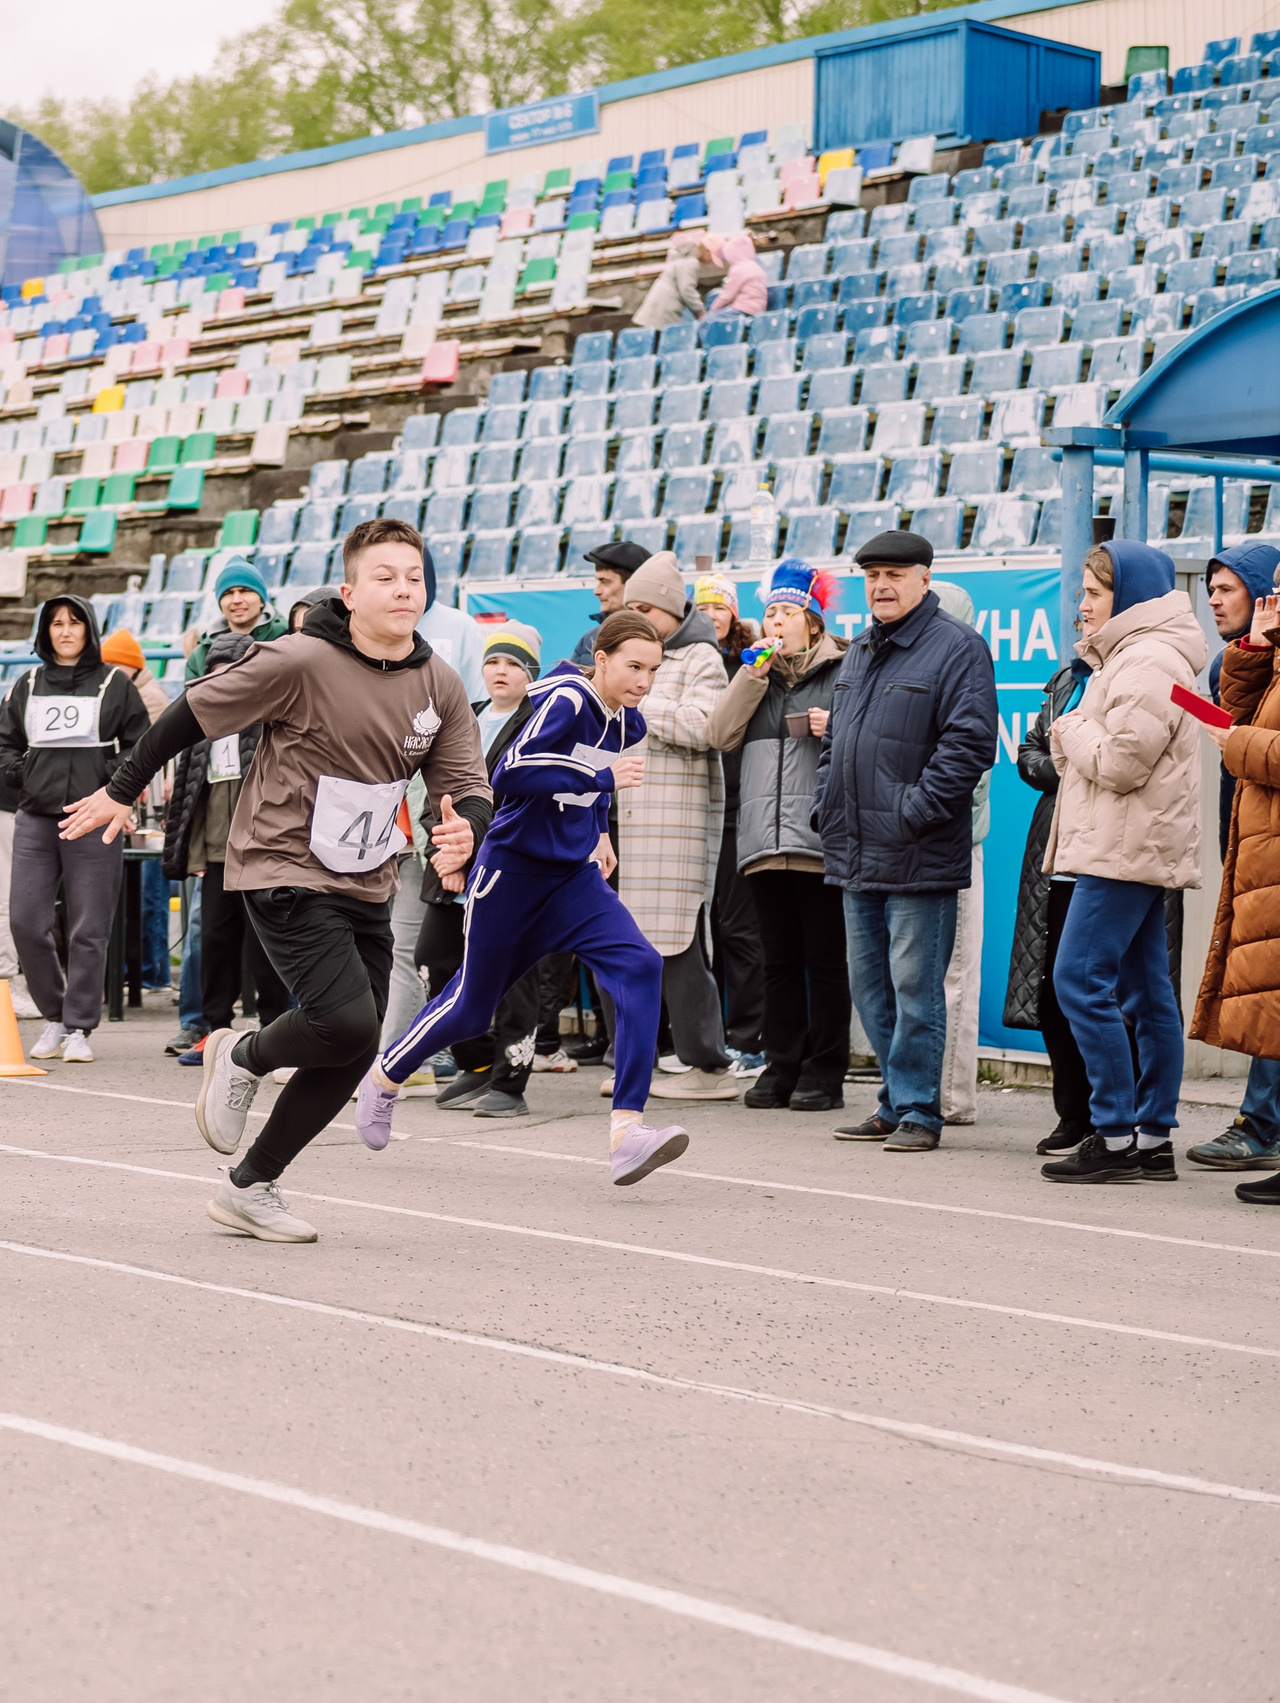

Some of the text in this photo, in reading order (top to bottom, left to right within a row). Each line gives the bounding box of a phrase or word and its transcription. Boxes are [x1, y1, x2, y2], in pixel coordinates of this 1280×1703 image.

[45, 705, 79, 732] 29
[222, 740, 236, 768] 1
[337, 802, 400, 861] 44
